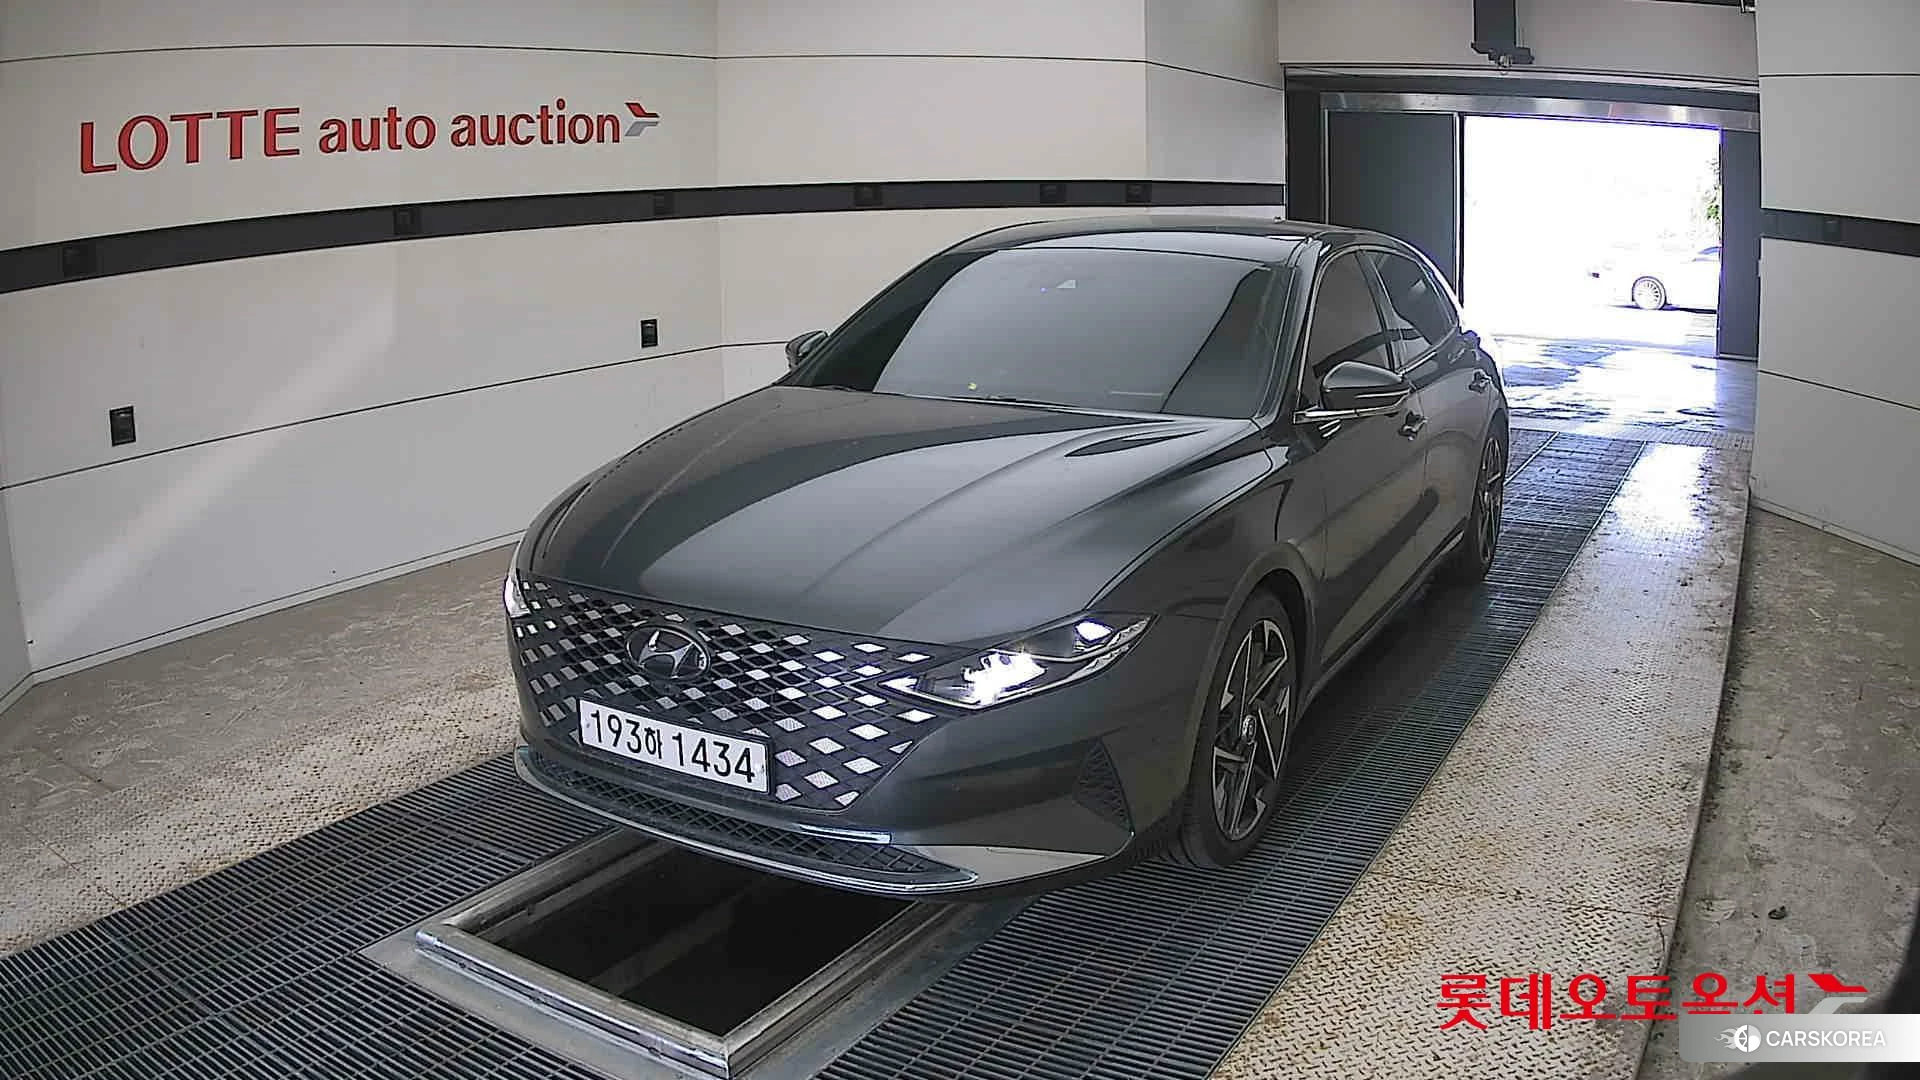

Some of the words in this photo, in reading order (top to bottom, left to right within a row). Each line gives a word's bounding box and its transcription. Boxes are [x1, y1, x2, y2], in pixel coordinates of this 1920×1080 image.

[80, 107, 300, 174] LOTTE
[318, 105, 437, 154] auto
[450, 98, 621, 147] auction
[591, 709, 663, 759] 193하
[671, 732, 756, 783] 1434
